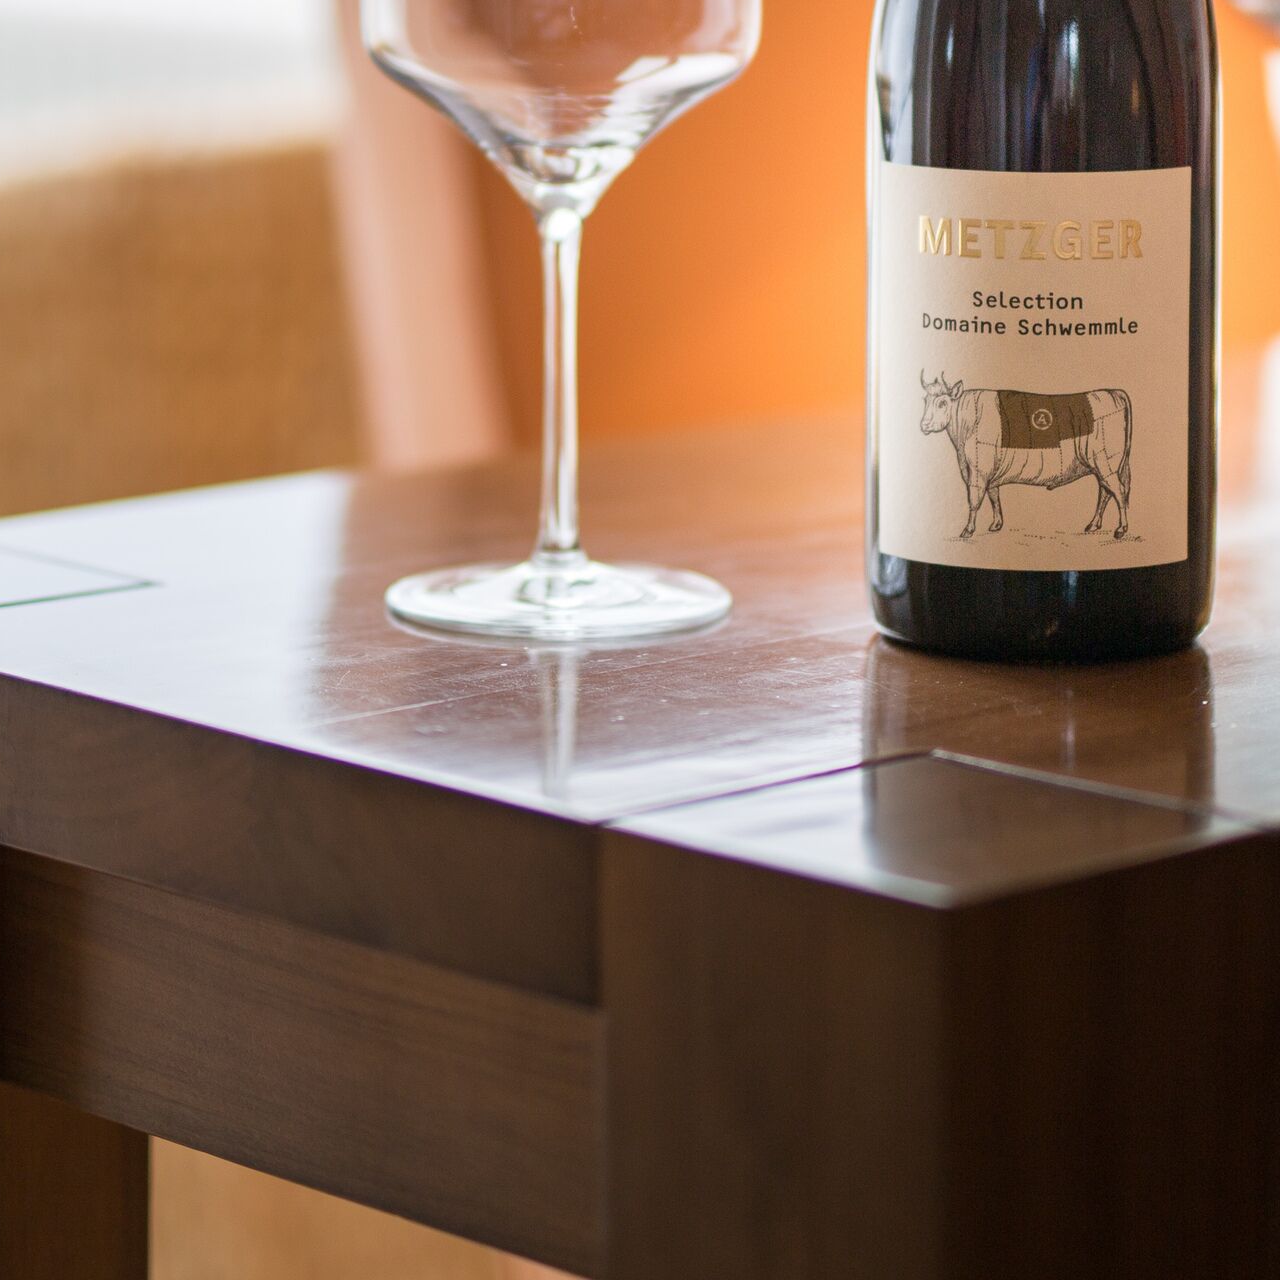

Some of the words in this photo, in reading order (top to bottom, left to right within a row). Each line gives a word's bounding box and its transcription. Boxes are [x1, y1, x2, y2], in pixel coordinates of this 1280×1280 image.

[919, 215, 1143, 260] METZGER
[972, 291, 1083, 310] Selection
[922, 313, 1006, 335] Domaine
[1018, 317, 1138, 336] Schwemmle
